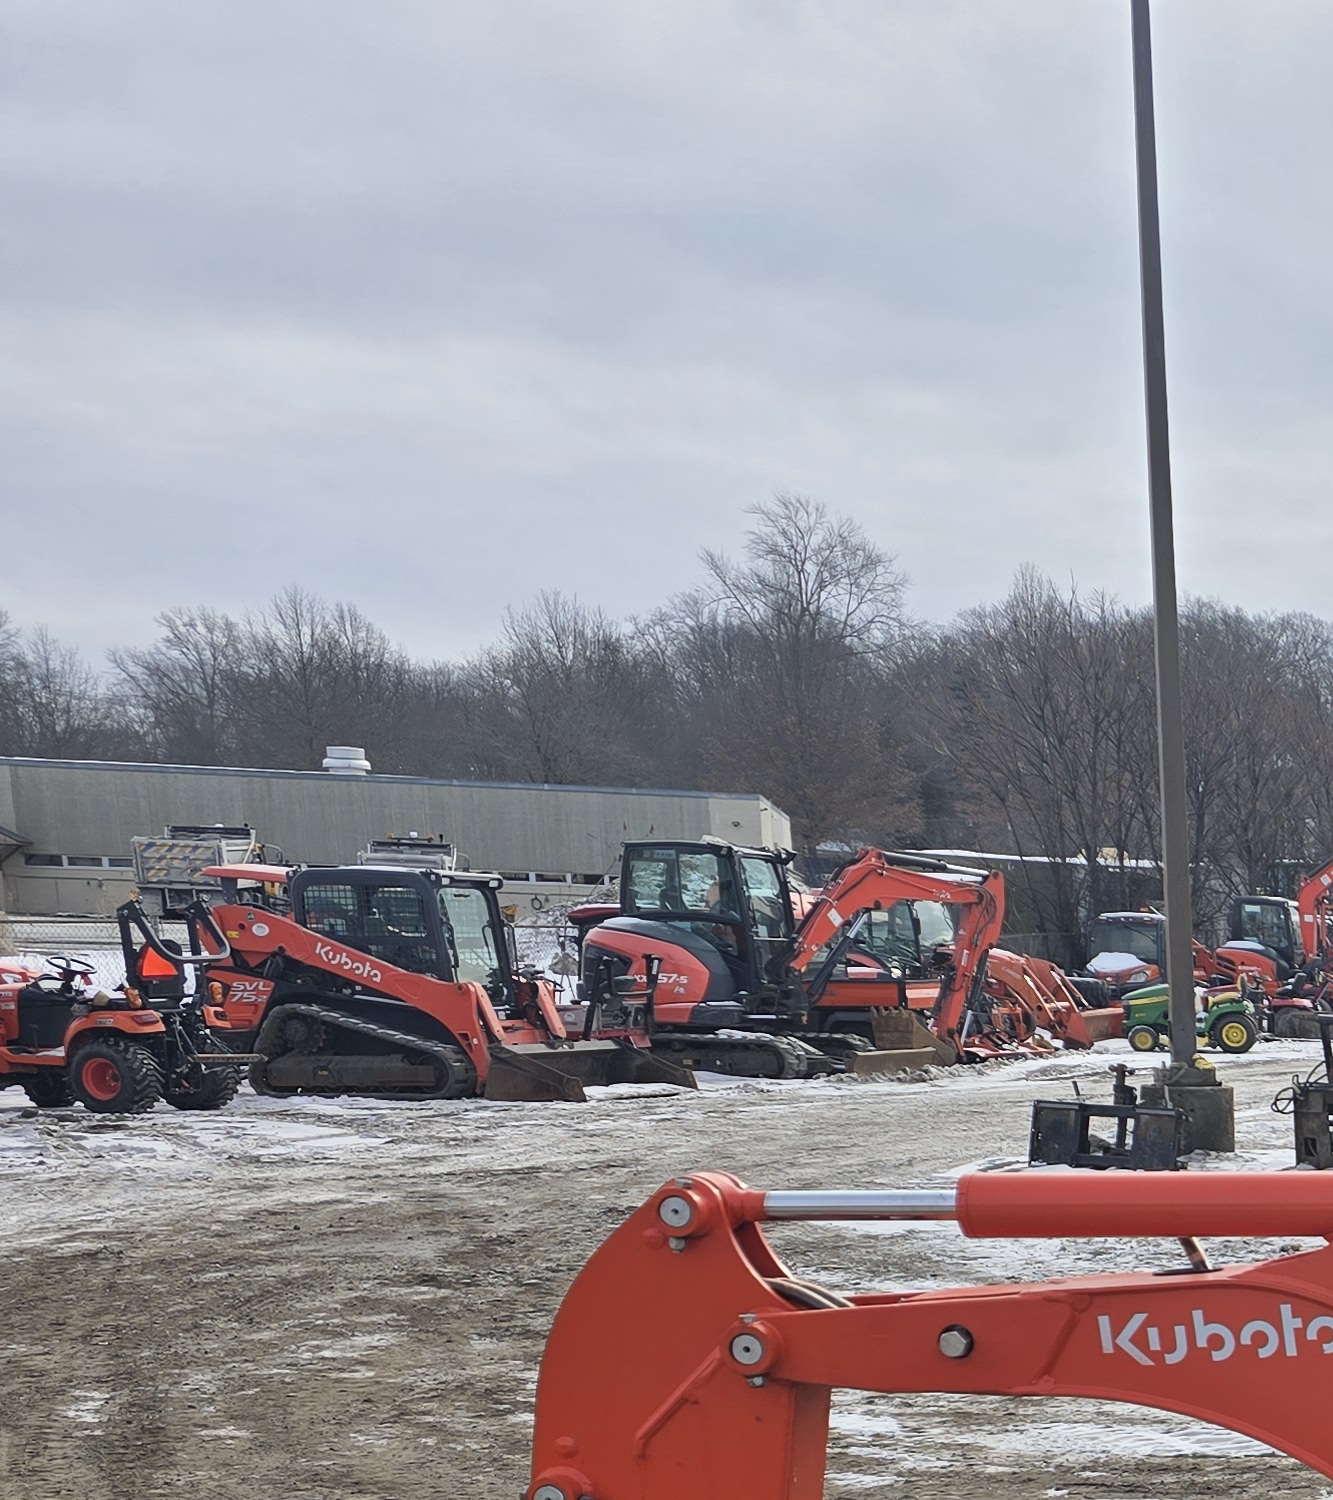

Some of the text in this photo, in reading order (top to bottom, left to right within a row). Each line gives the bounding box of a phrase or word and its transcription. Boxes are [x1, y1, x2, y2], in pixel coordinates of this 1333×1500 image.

[316, 942, 382, 982] Kubota
[230, 982, 271, 990] SVL
[230, 992, 267, 1002] 75-2
